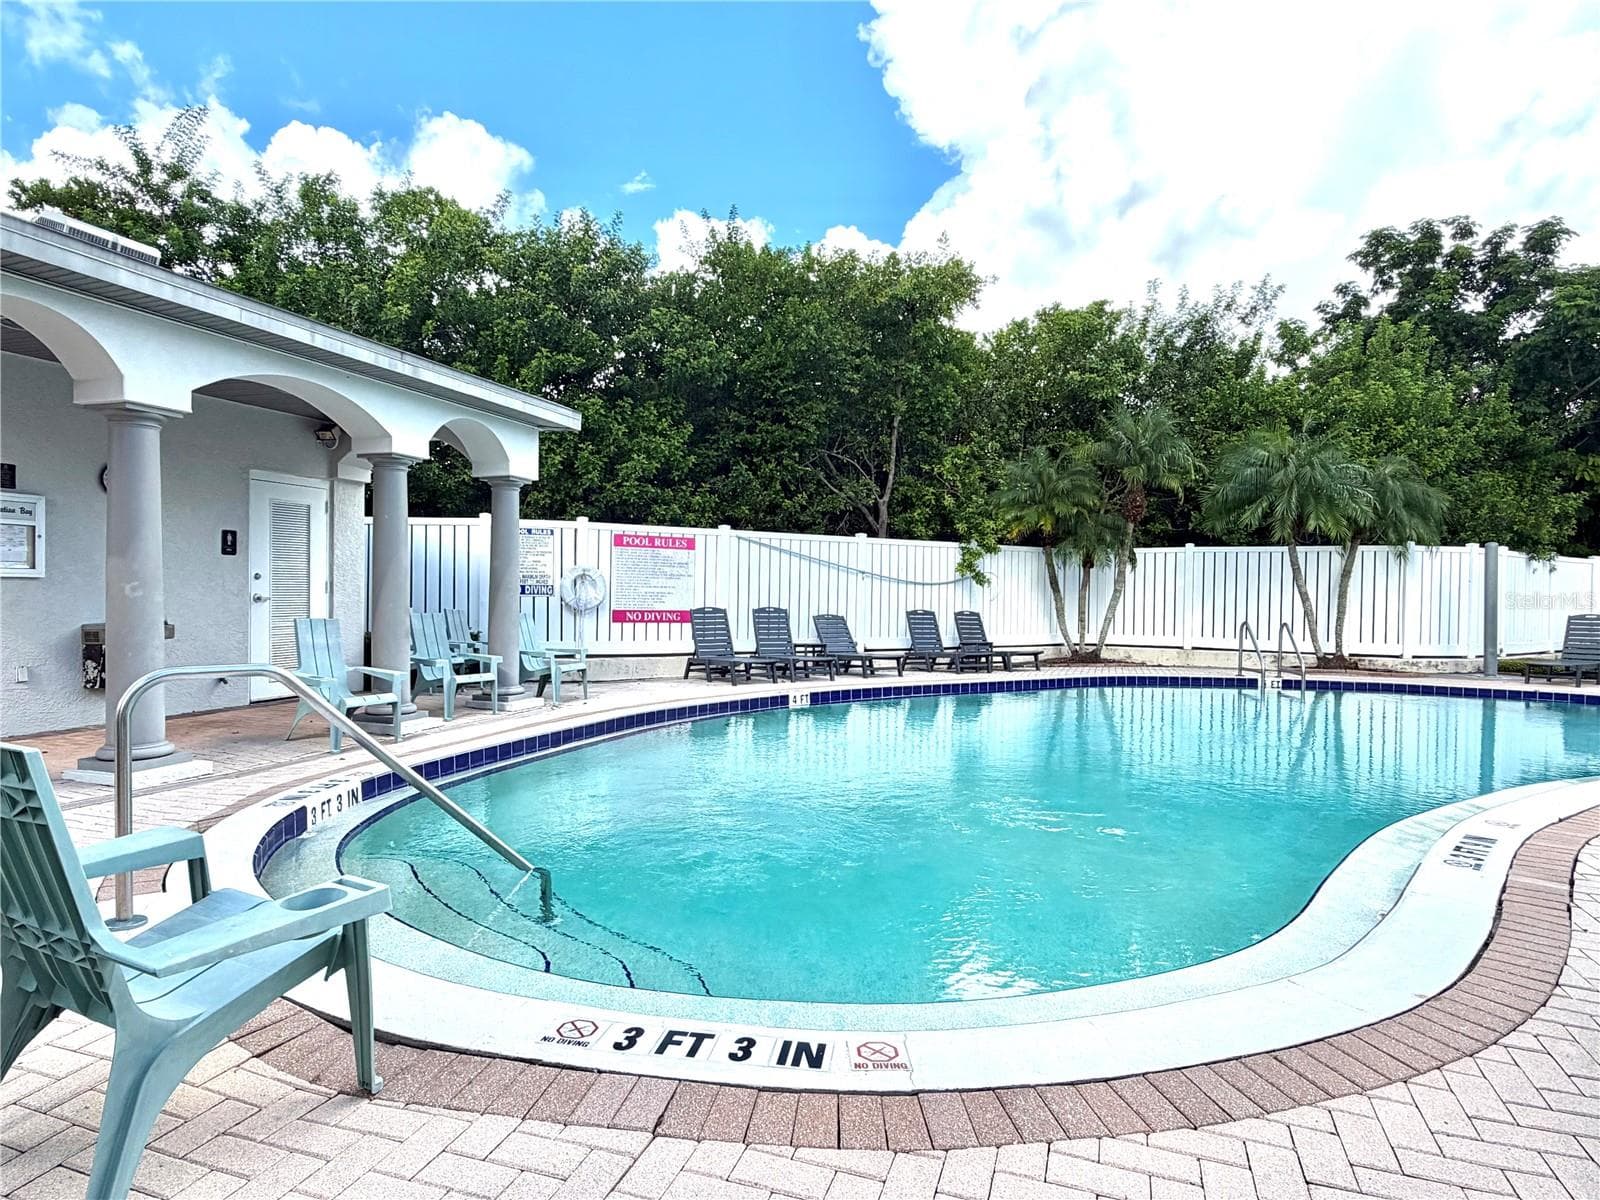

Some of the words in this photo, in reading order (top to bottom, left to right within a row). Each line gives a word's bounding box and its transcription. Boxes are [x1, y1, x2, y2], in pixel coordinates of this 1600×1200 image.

[622, 536, 652, 546] POOL
[654, 538, 688, 548] RULES
[525, 585, 553, 595] DIVING
[625, 612, 642, 620] NO
[644, 612, 681, 621] DIVING
[792, 695, 797, 704] 4
[800, 694, 809, 704] FT
[311, 807, 317, 825] 3
[321, 798, 332, 820] FT
[336, 794, 343, 812] 3
[347, 787, 360, 807] IN
[540, 1035, 554, 1043] NO
[556, 1037, 590, 1048] DIVING
[612, 1026, 645, 1051] 3
[654, 1029, 716, 1058] FT
[728, 1036, 757, 1062] 3
[776, 1040, 827, 1069] IN
[854, 1062, 869, 1070] NO
[872, 1062, 908, 1070] DIVING
